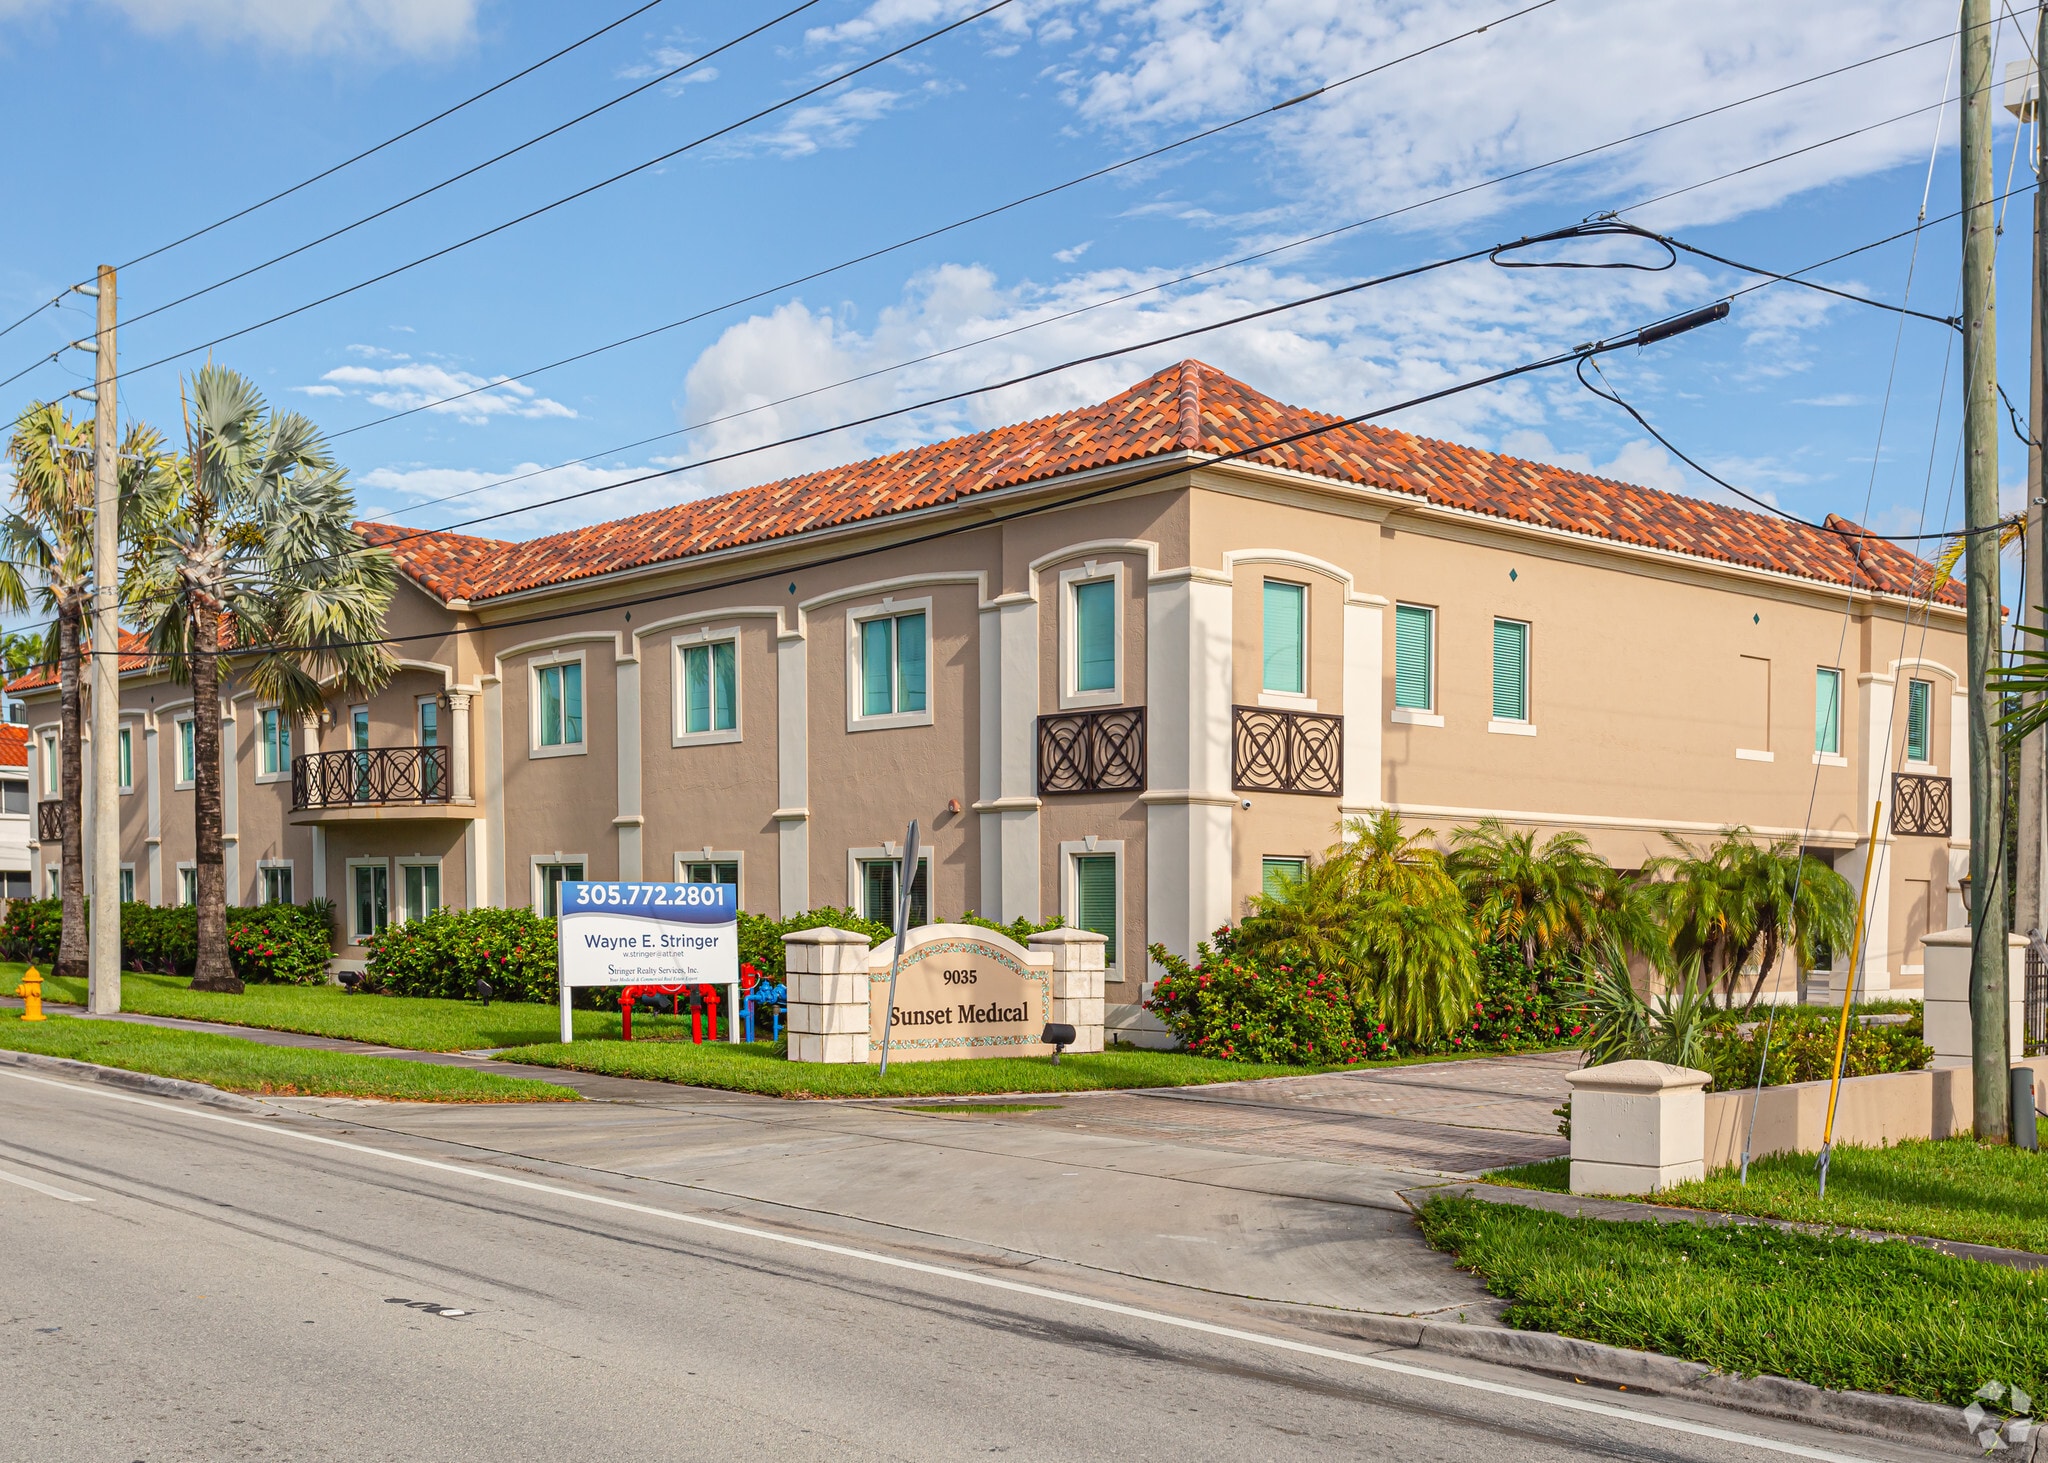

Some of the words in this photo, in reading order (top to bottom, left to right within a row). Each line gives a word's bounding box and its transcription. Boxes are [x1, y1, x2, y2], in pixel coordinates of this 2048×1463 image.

[576, 884, 724, 906] 305.772.2801
[585, 934, 637, 951] Wayne
[643, 934, 655, 948] E.
[660, 934, 719, 950] Stringer
[623, 950, 685, 959] w.stringer@att.net
[608, 963, 636, 976] Stringer
[637, 966, 657, 976] Realty
[687, 966, 699, 974] Inc.
[943, 969, 978, 986] 9035
[890, 1006, 953, 1027] Sunset
[957, 1001, 1029, 1024] Medical
